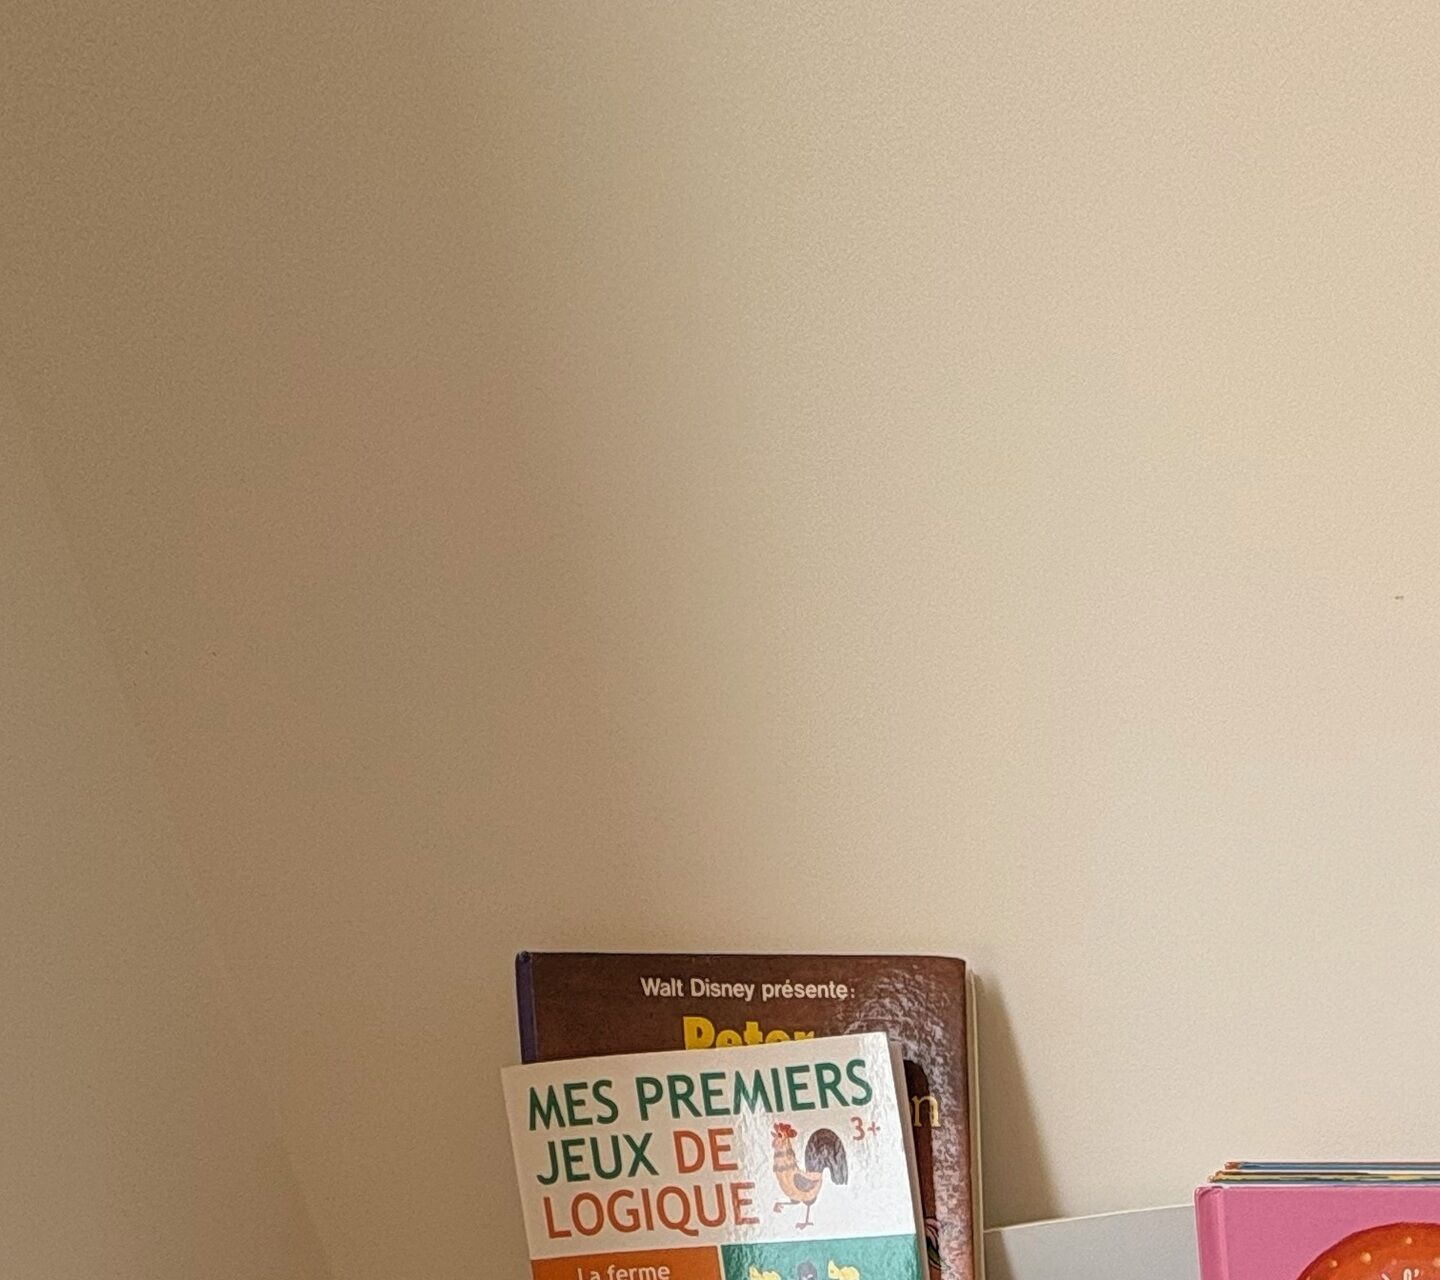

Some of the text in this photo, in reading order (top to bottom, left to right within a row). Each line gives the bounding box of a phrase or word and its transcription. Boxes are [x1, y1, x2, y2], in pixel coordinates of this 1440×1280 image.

[641, 977, 856, 1001] Walt Disney présente:
[529, 1079, 619, 1131] MES
[636, 1058, 873, 1121] PREMIERS
[537, 1127, 739, 1186] JEUX DE
[850, 1116, 881, 1142] 3+
[544, 1181, 760, 1239] LOGIQUE
